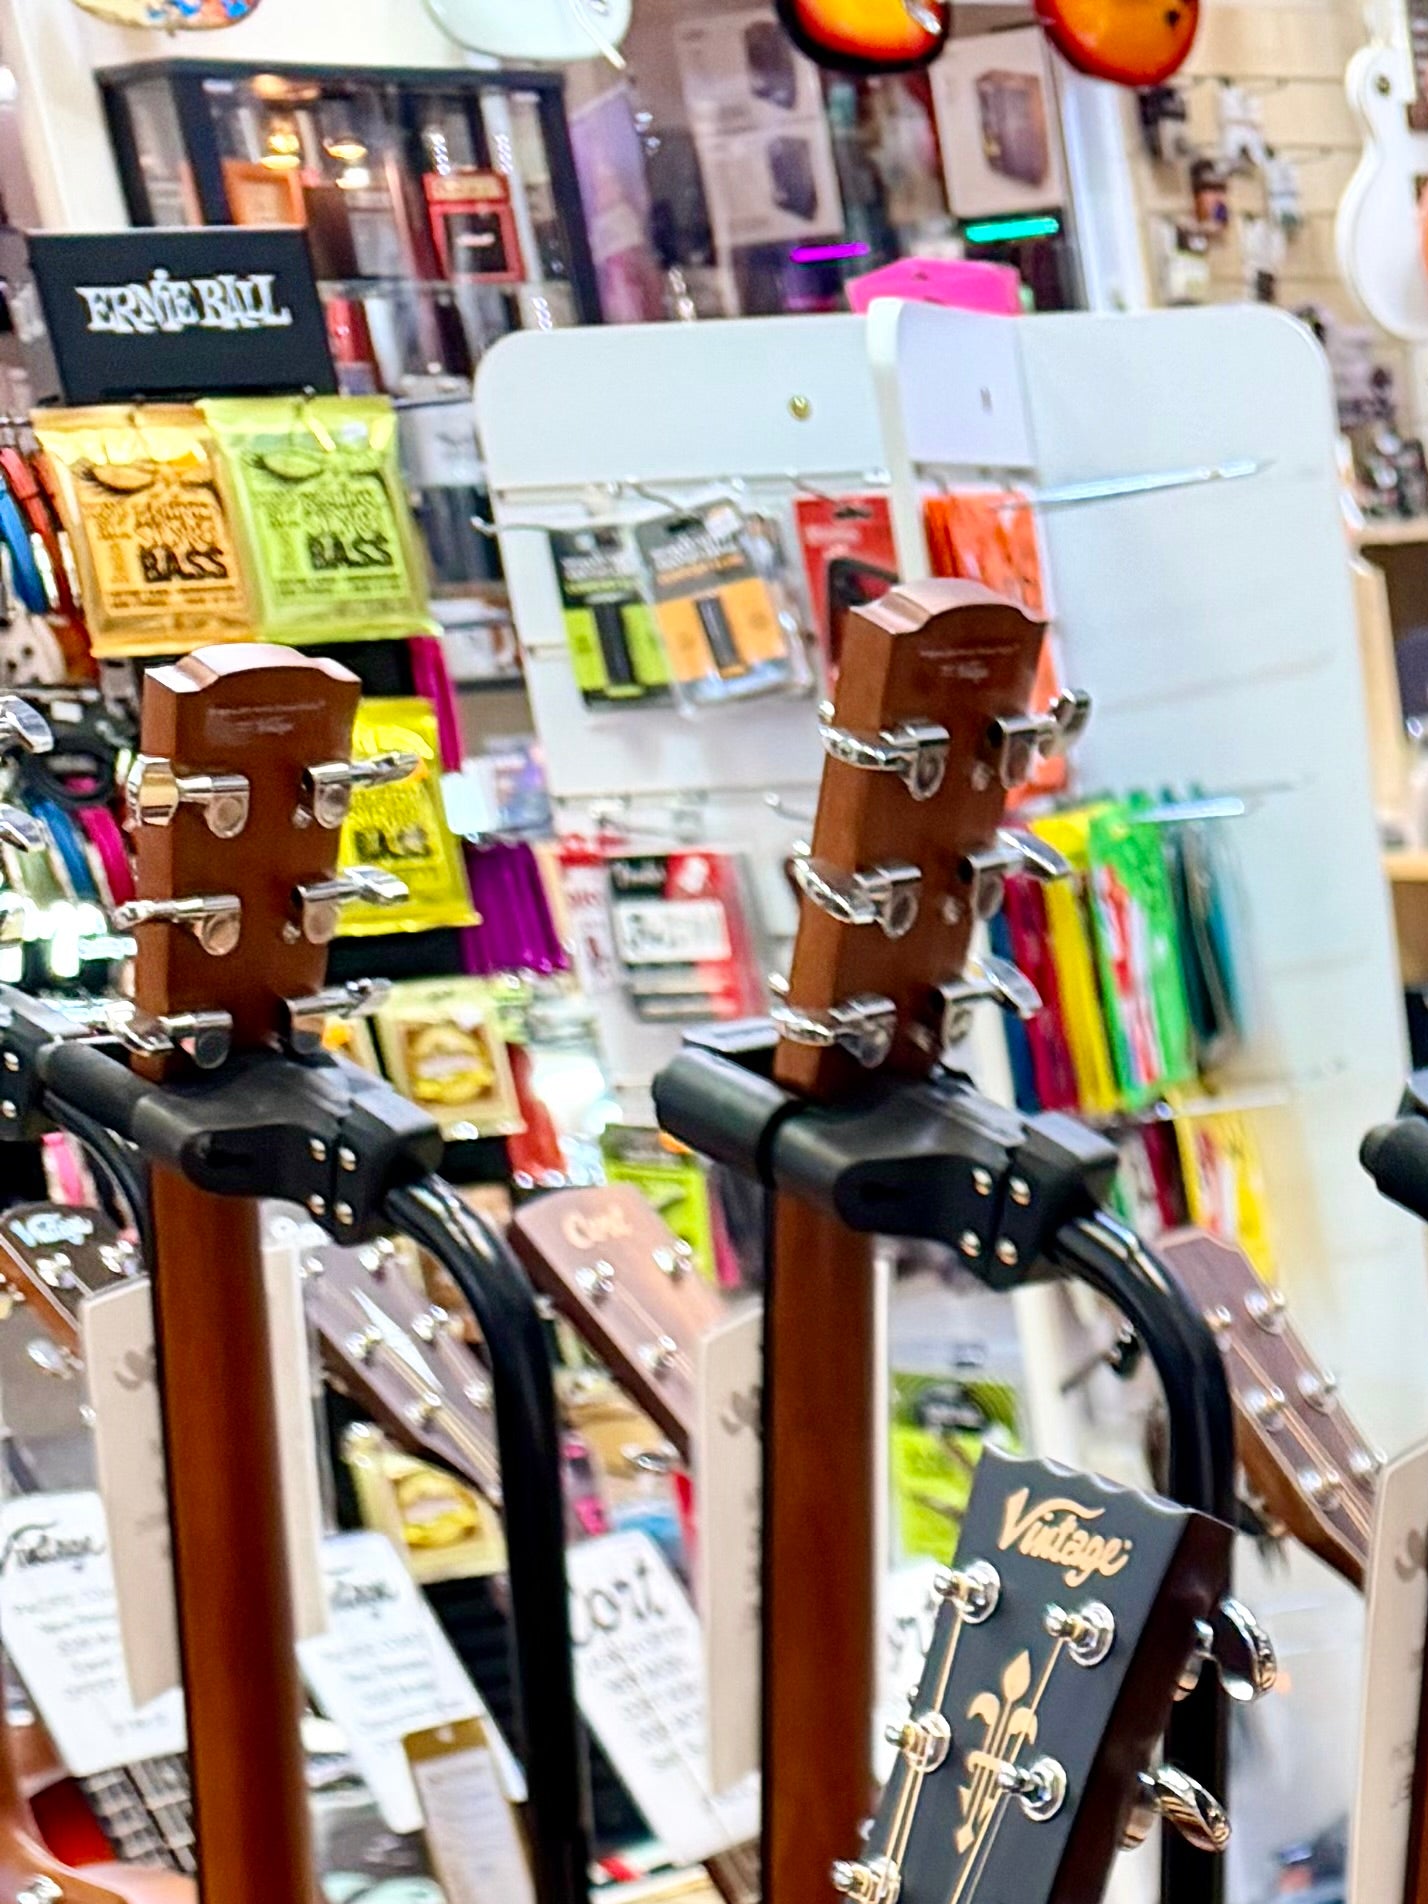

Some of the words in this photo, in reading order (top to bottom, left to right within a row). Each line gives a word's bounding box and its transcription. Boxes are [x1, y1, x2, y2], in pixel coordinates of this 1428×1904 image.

[75, 268, 200, 333] ERNIE
[195, 272, 293, 330] BALL
[139, 544, 229, 584] BASS
[308, 530, 394, 572] BASS
[998, 1487, 1130, 1588] Vintage
